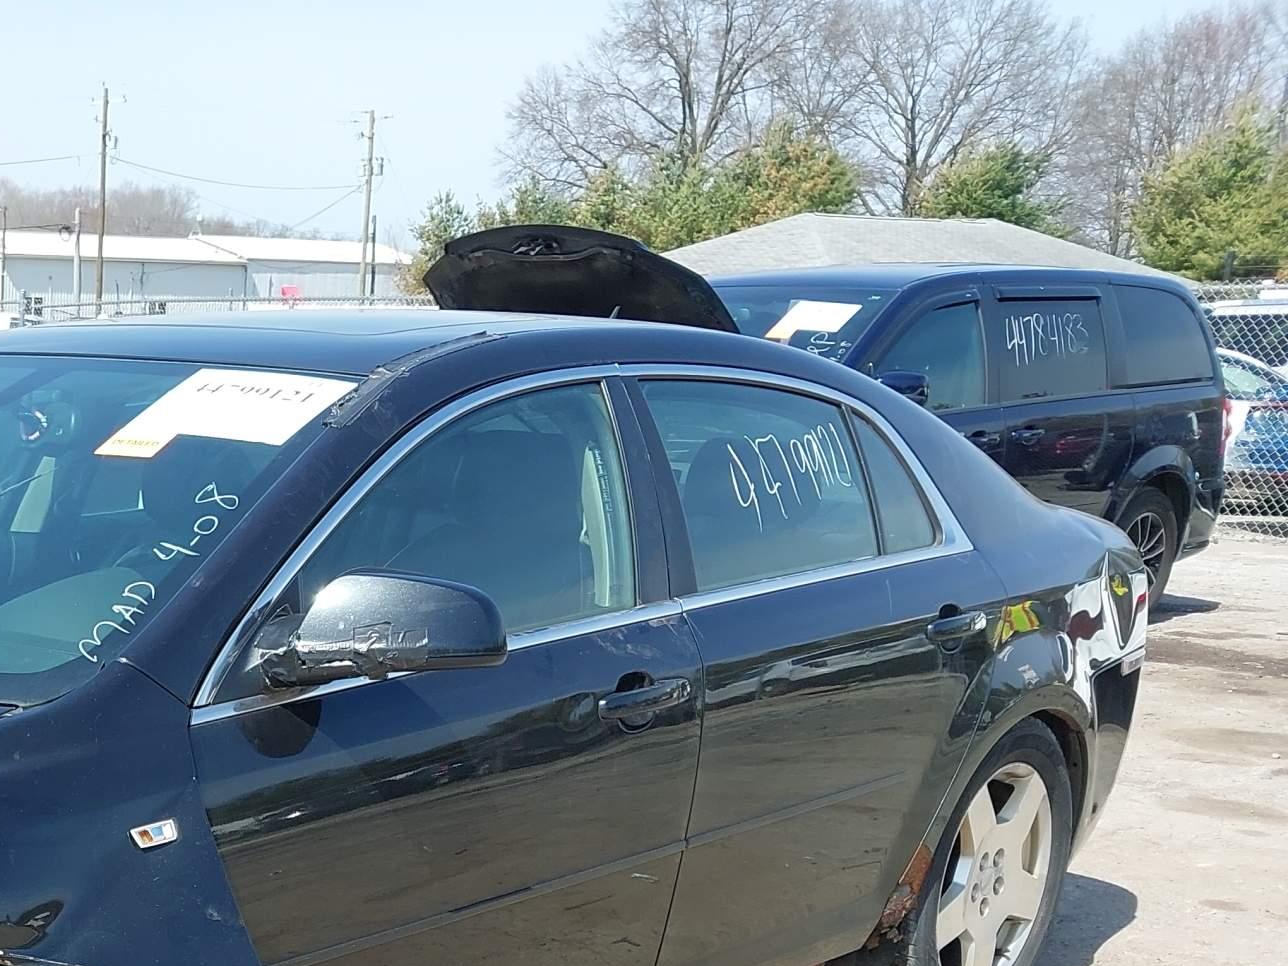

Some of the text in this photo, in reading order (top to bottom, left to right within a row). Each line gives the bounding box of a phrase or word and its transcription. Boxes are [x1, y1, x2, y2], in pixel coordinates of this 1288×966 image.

[1005, 312, 1089, 368] 44784183
[726, 422, 853, 534] 44799121
[78, 481, 240, 662] MAD 4-08
